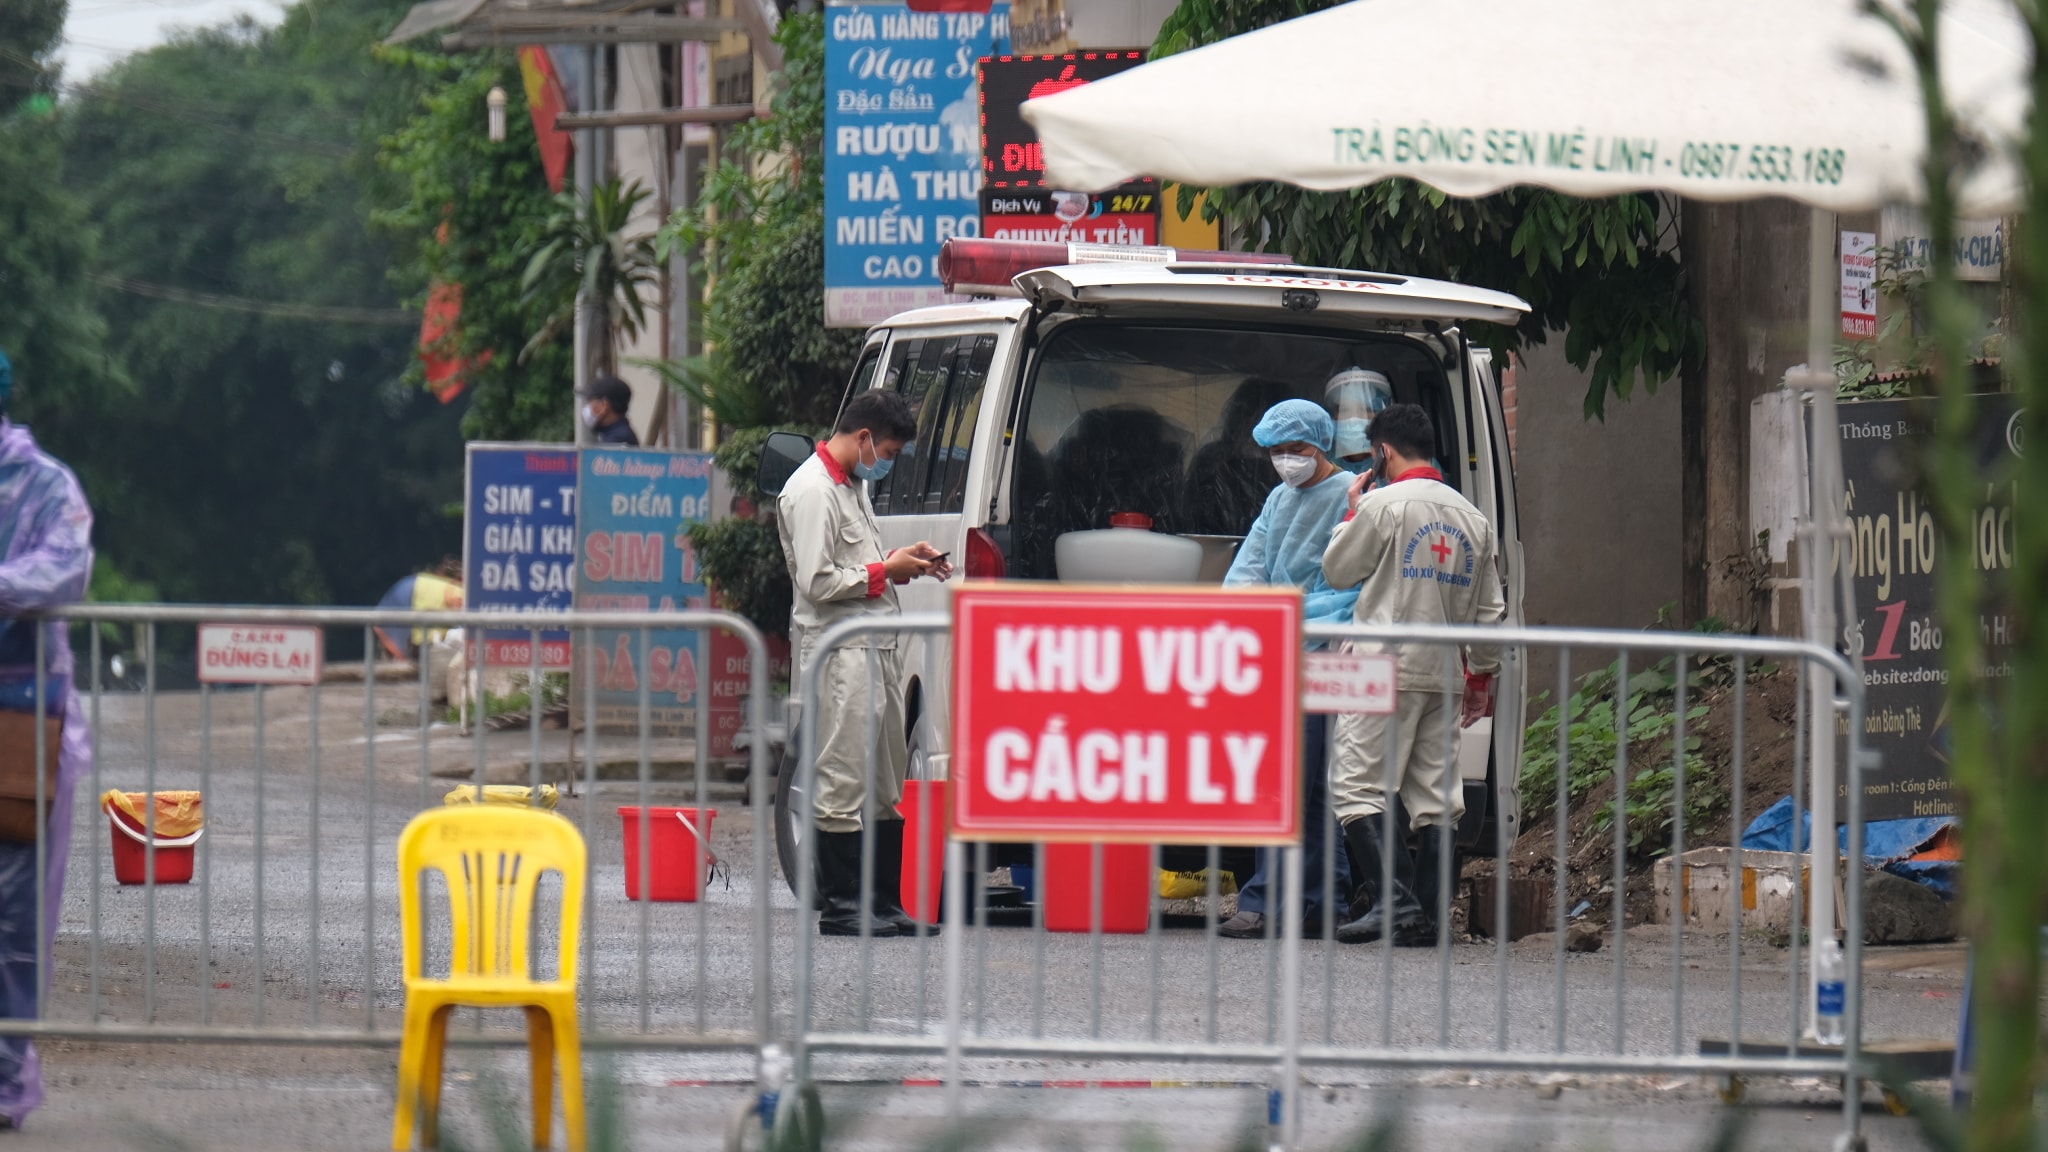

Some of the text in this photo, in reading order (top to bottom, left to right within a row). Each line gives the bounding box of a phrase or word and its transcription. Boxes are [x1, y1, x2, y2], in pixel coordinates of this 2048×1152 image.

[833, 5, 876, 41] CỬA
[881, 9, 939, 40] HÀNG
[944, 12, 985, 44] TẠP
[848, 46, 937, 86] Nga
[837, 84, 935, 116] Đặc Sản
[836, 121, 940, 161] RƯỢU
[1331, 118, 1386, 164] TRÀ
[1483, 128, 1536, 166] SEN
[1545, 126, 1586, 170] MÊ
[1593, 136, 1657, 175] LINH
[1680, 141, 1847, 186] 0987.553.188
[848, 165, 900, 202] HÀ
[991, 195, 1152, 215] Dịch Vụ 24/7
[836, 204, 924, 246] MIẾN
[864, 255, 923, 280] CAO
[1217, 276, 1384, 290] TOYOTA
[1839, 420, 1892, 440] Thống
[484, 484, 533, 515] SIM
[484, 517, 534, 555] GIẢI
[480, 553, 522, 592] ĐÁ
[583, 530, 665, 583] SIM
[1402, 565, 1418, 581] ĐỘI
[1403, 537, 1420, 564] TRUNG
[1465, 554, 1474, 574] LINH
[1863, 600, 1907, 661] 1
[1910, 617, 1943, 651] Bảo
[206, 645, 312, 674] DỪNG LẠI
[993, 620, 1263, 709] KHU VỰC
[1883, 705, 1905, 738] Bằng
[983, 713, 1268, 804] CÁCH LY
